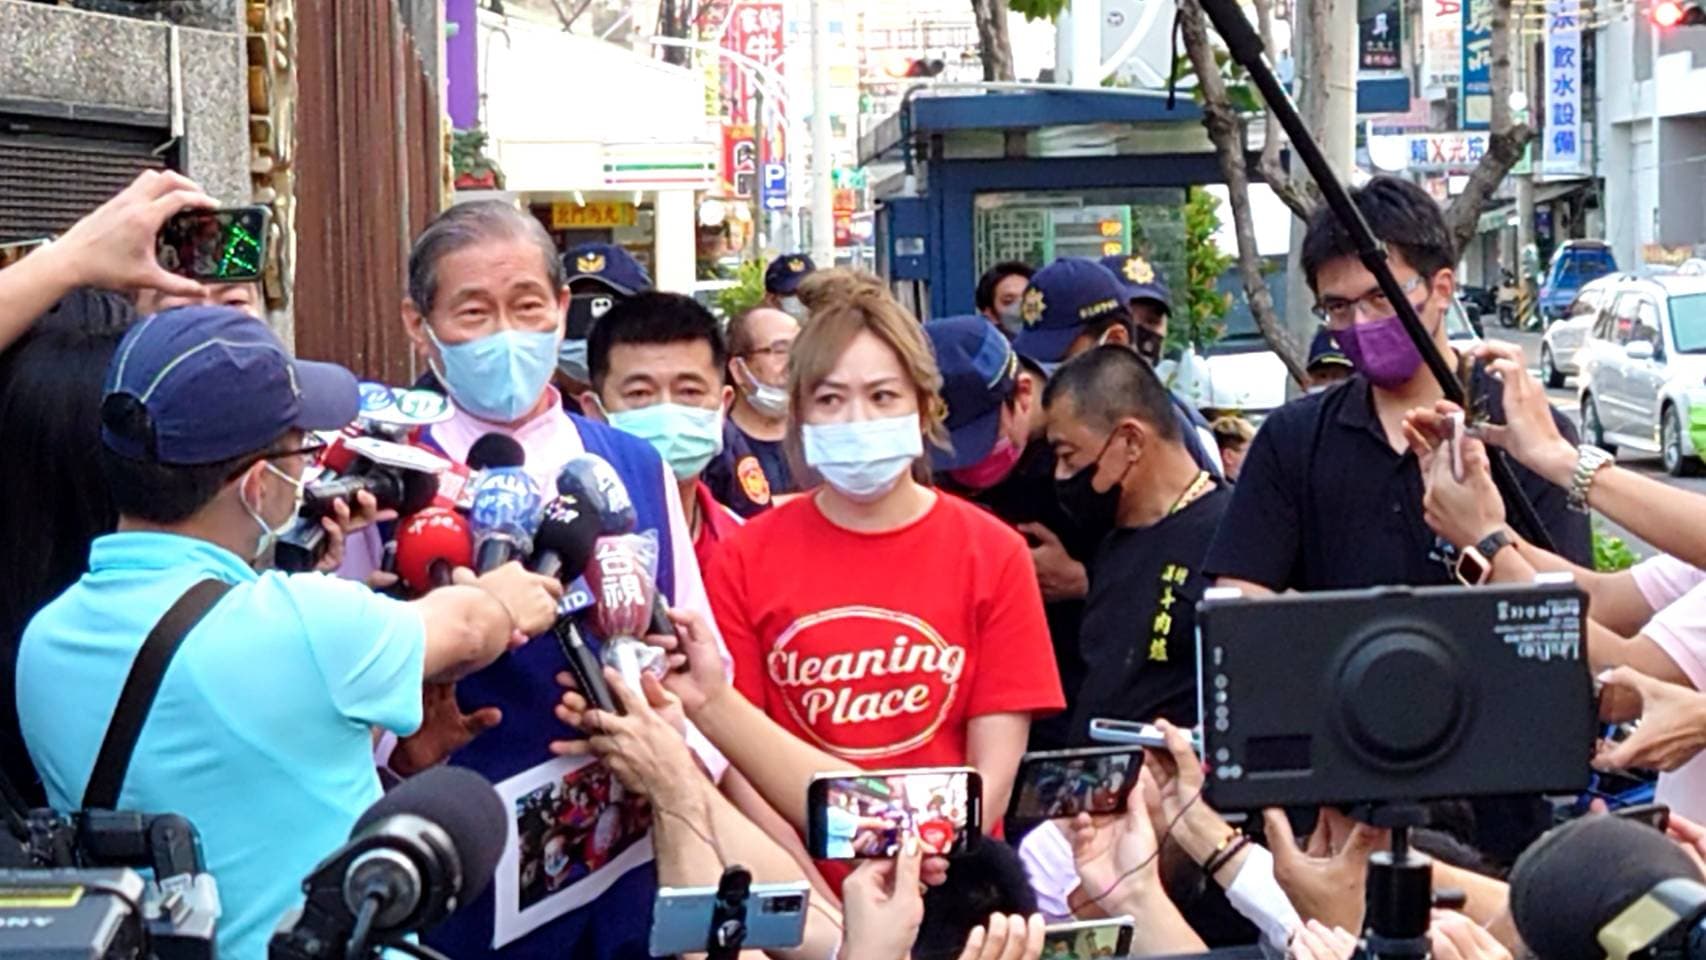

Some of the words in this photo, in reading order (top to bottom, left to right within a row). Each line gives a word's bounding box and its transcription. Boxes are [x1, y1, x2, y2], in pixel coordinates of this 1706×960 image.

[765, 164, 785, 188] P
[596, 543, 646, 608] 台視
[557, 590, 588, 615] TD
[767, 635, 966, 688] Cleaning
[802, 684, 930, 726] Place
[0, 916, 54, 928] NY
